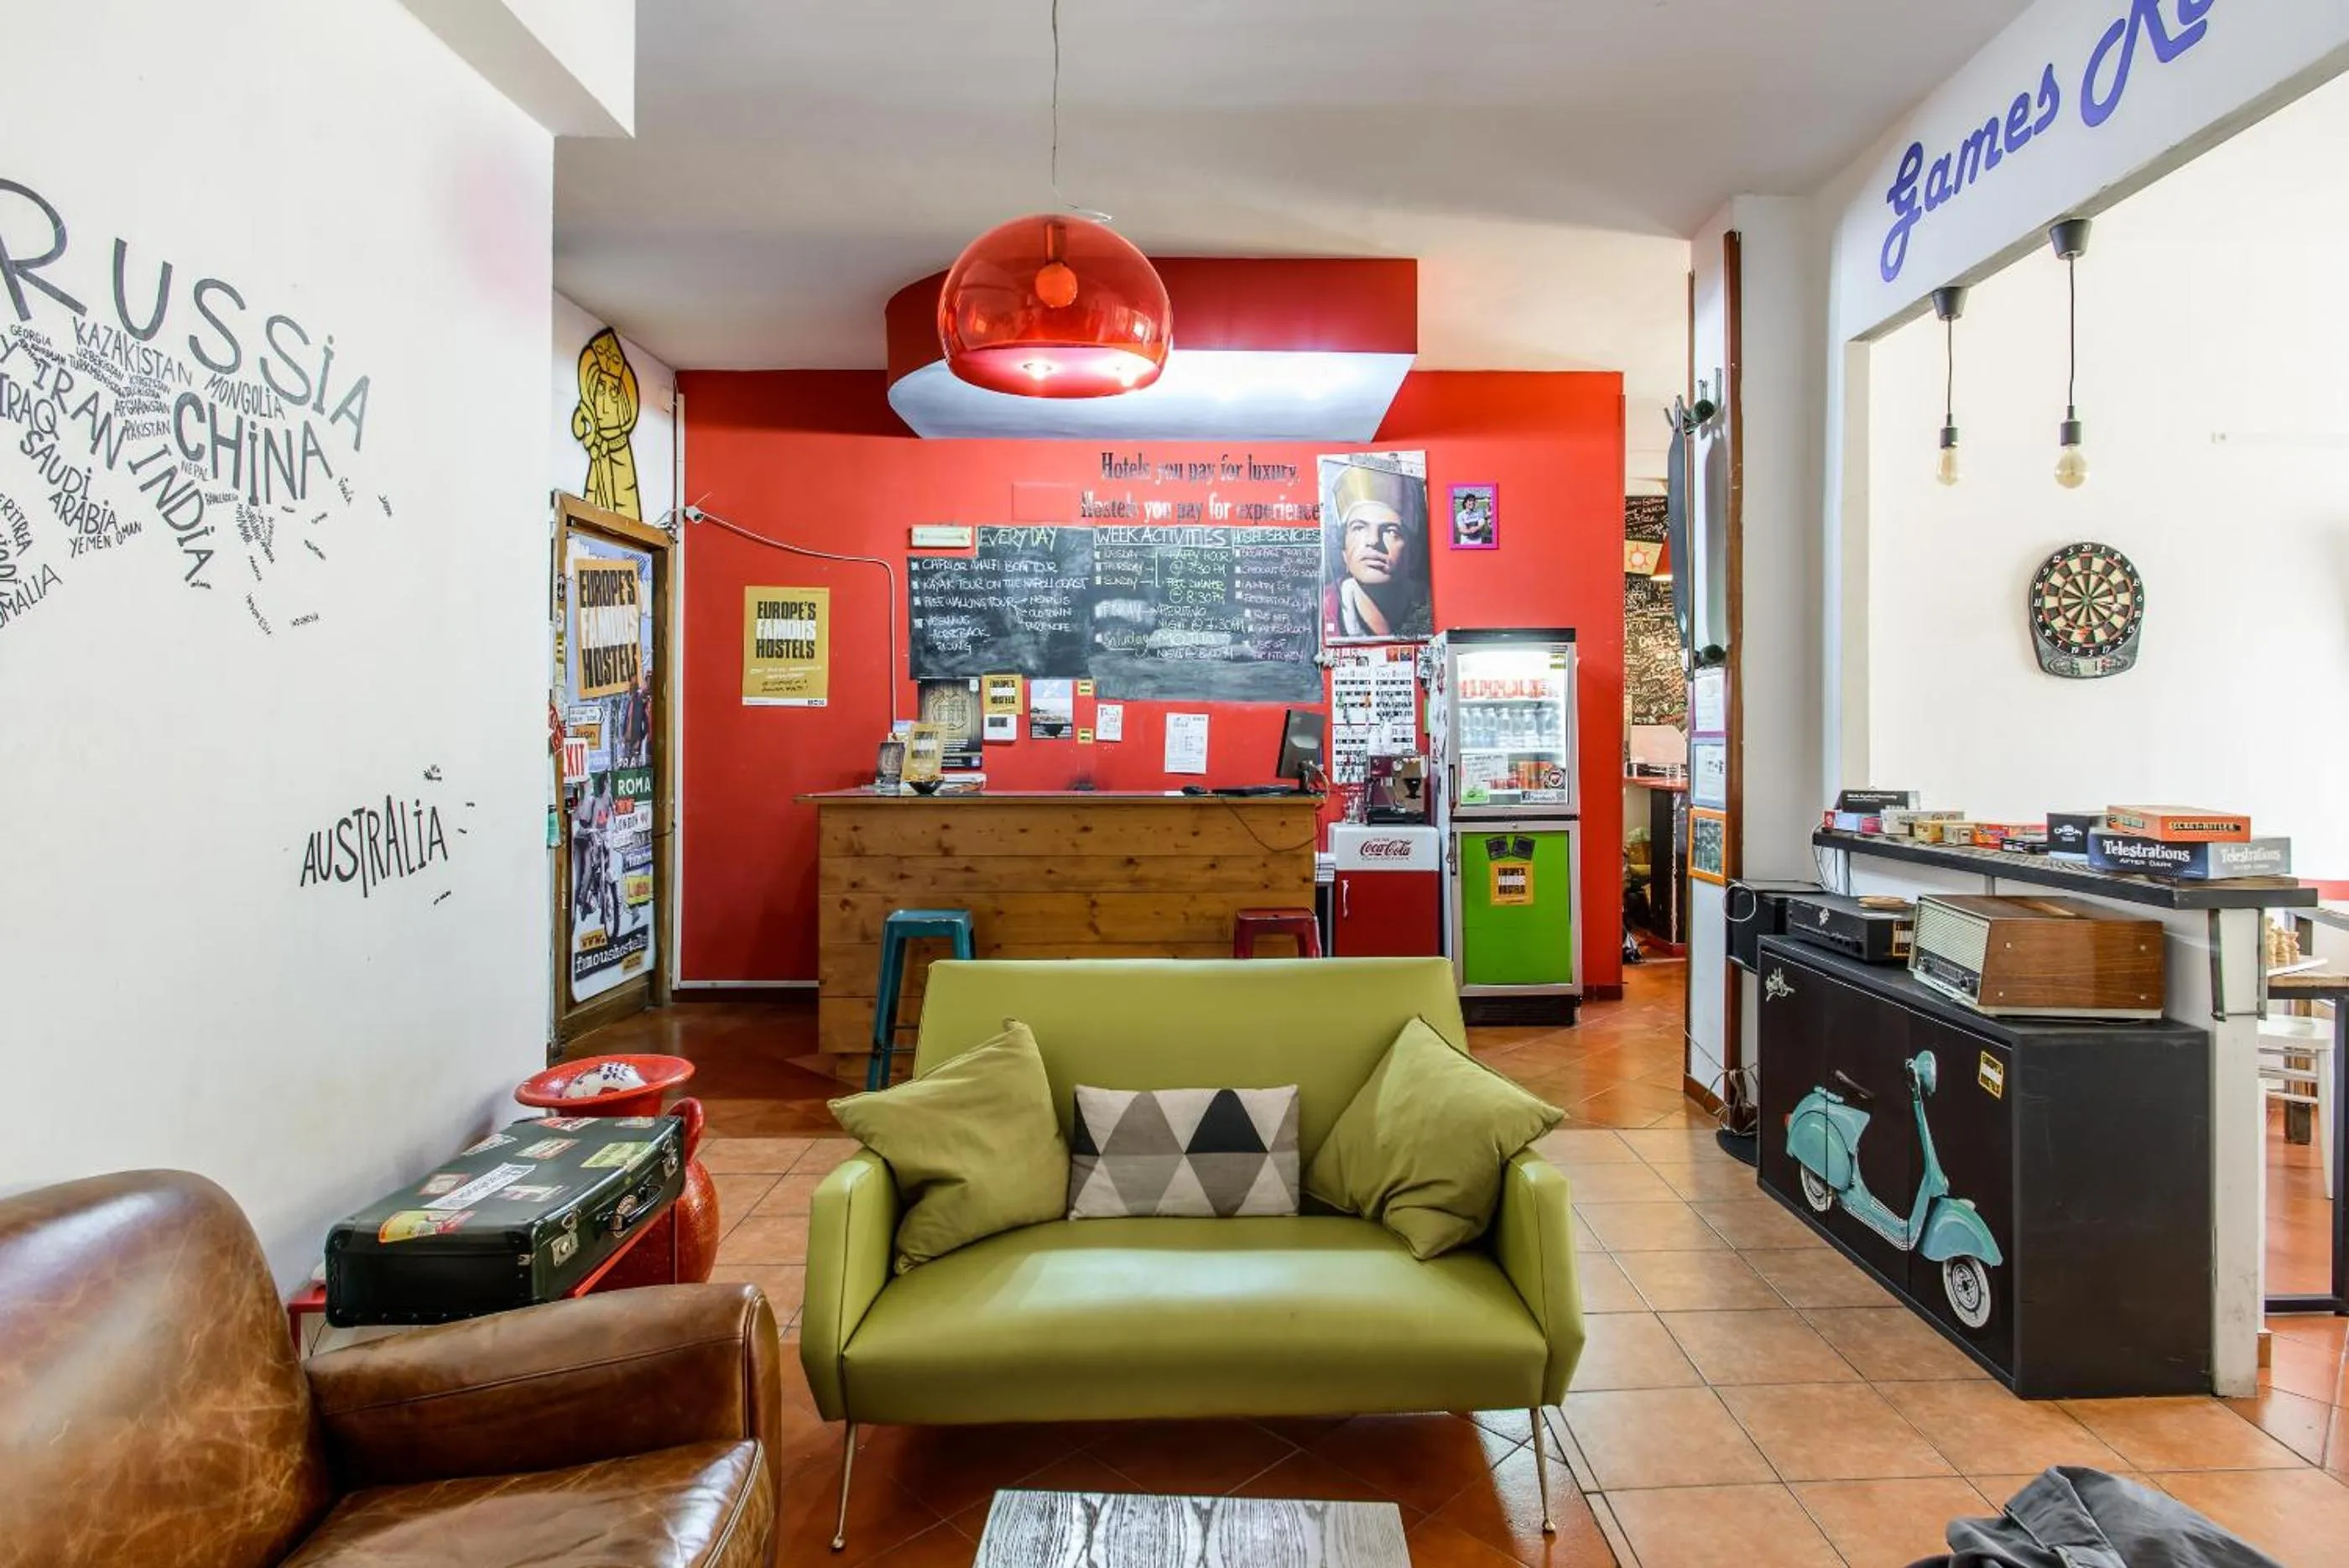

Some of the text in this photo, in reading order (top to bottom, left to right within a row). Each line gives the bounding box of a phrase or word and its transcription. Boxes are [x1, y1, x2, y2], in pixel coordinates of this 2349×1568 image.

[1880, 63, 2060, 282] Games
[74, 315, 193, 386] KAZAKISTAN
[205, 372, 286, 420] MONGOLIA
[125, 419, 171, 441] PAKISTAN
[173, 391, 334, 507] CHINA
[20, 430, 119, 534] SAUDI ARABIA
[180, 460, 211, 481] NEPAL
[1101, 451, 1150, 479] Hotels
[1155, 462, 1183, 485] you
[1189, 462, 1216, 485] pay
[1221, 453, 1243, 481] for
[128, 443, 215, 582] INDIA
[1081, 490, 1138, 518] Hostels
[1143, 501, 1172, 524] you
[1177, 502, 1203, 523] pay
[1208, 492, 1231, 520] for
[69, 534, 112, 559] YEMEN
[1096, 526, 1227, 546] WEEK ACTIVITIES
[579, 569, 635, 608] EUROPE'S
[757, 601, 816, 620] EUROPE'S
[756, 619, 817, 639] FAMOUS
[581, 642, 638, 690] HOSTELS
[756, 639, 815, 659] HOSTELS
[563, 742, 586, 778] XIT
[617, 776, 652, 796] ROMA
[300, 794, 449, 899] AUSTRALIA
[2103, 839, 2190, 862] Telestrations
[2220, 847, 2282, 863] Telestrations
